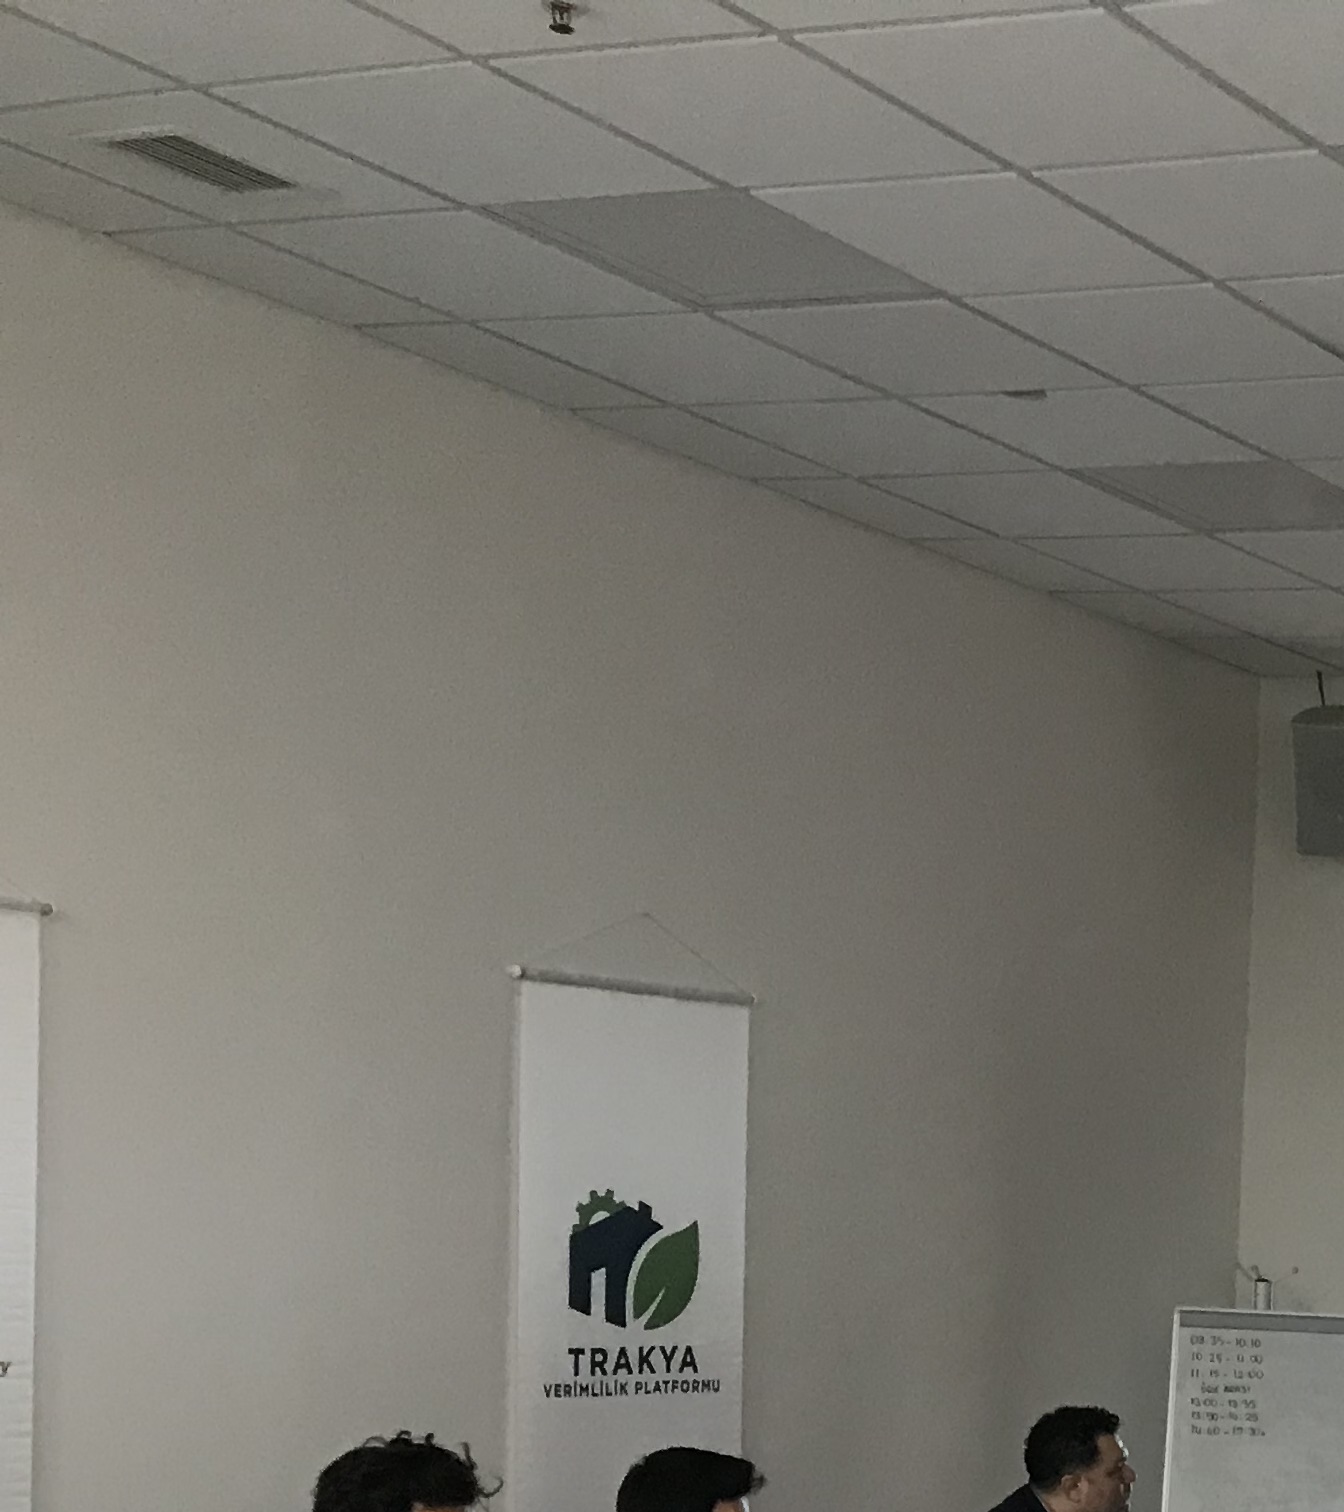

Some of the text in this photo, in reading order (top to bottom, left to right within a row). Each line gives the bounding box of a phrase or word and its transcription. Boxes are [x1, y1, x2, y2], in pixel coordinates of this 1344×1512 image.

[567, 1344, 699, 1377] TRAKYA
[543, 1379, 721, 1398] VERİMLİLİK PLATFORMU
